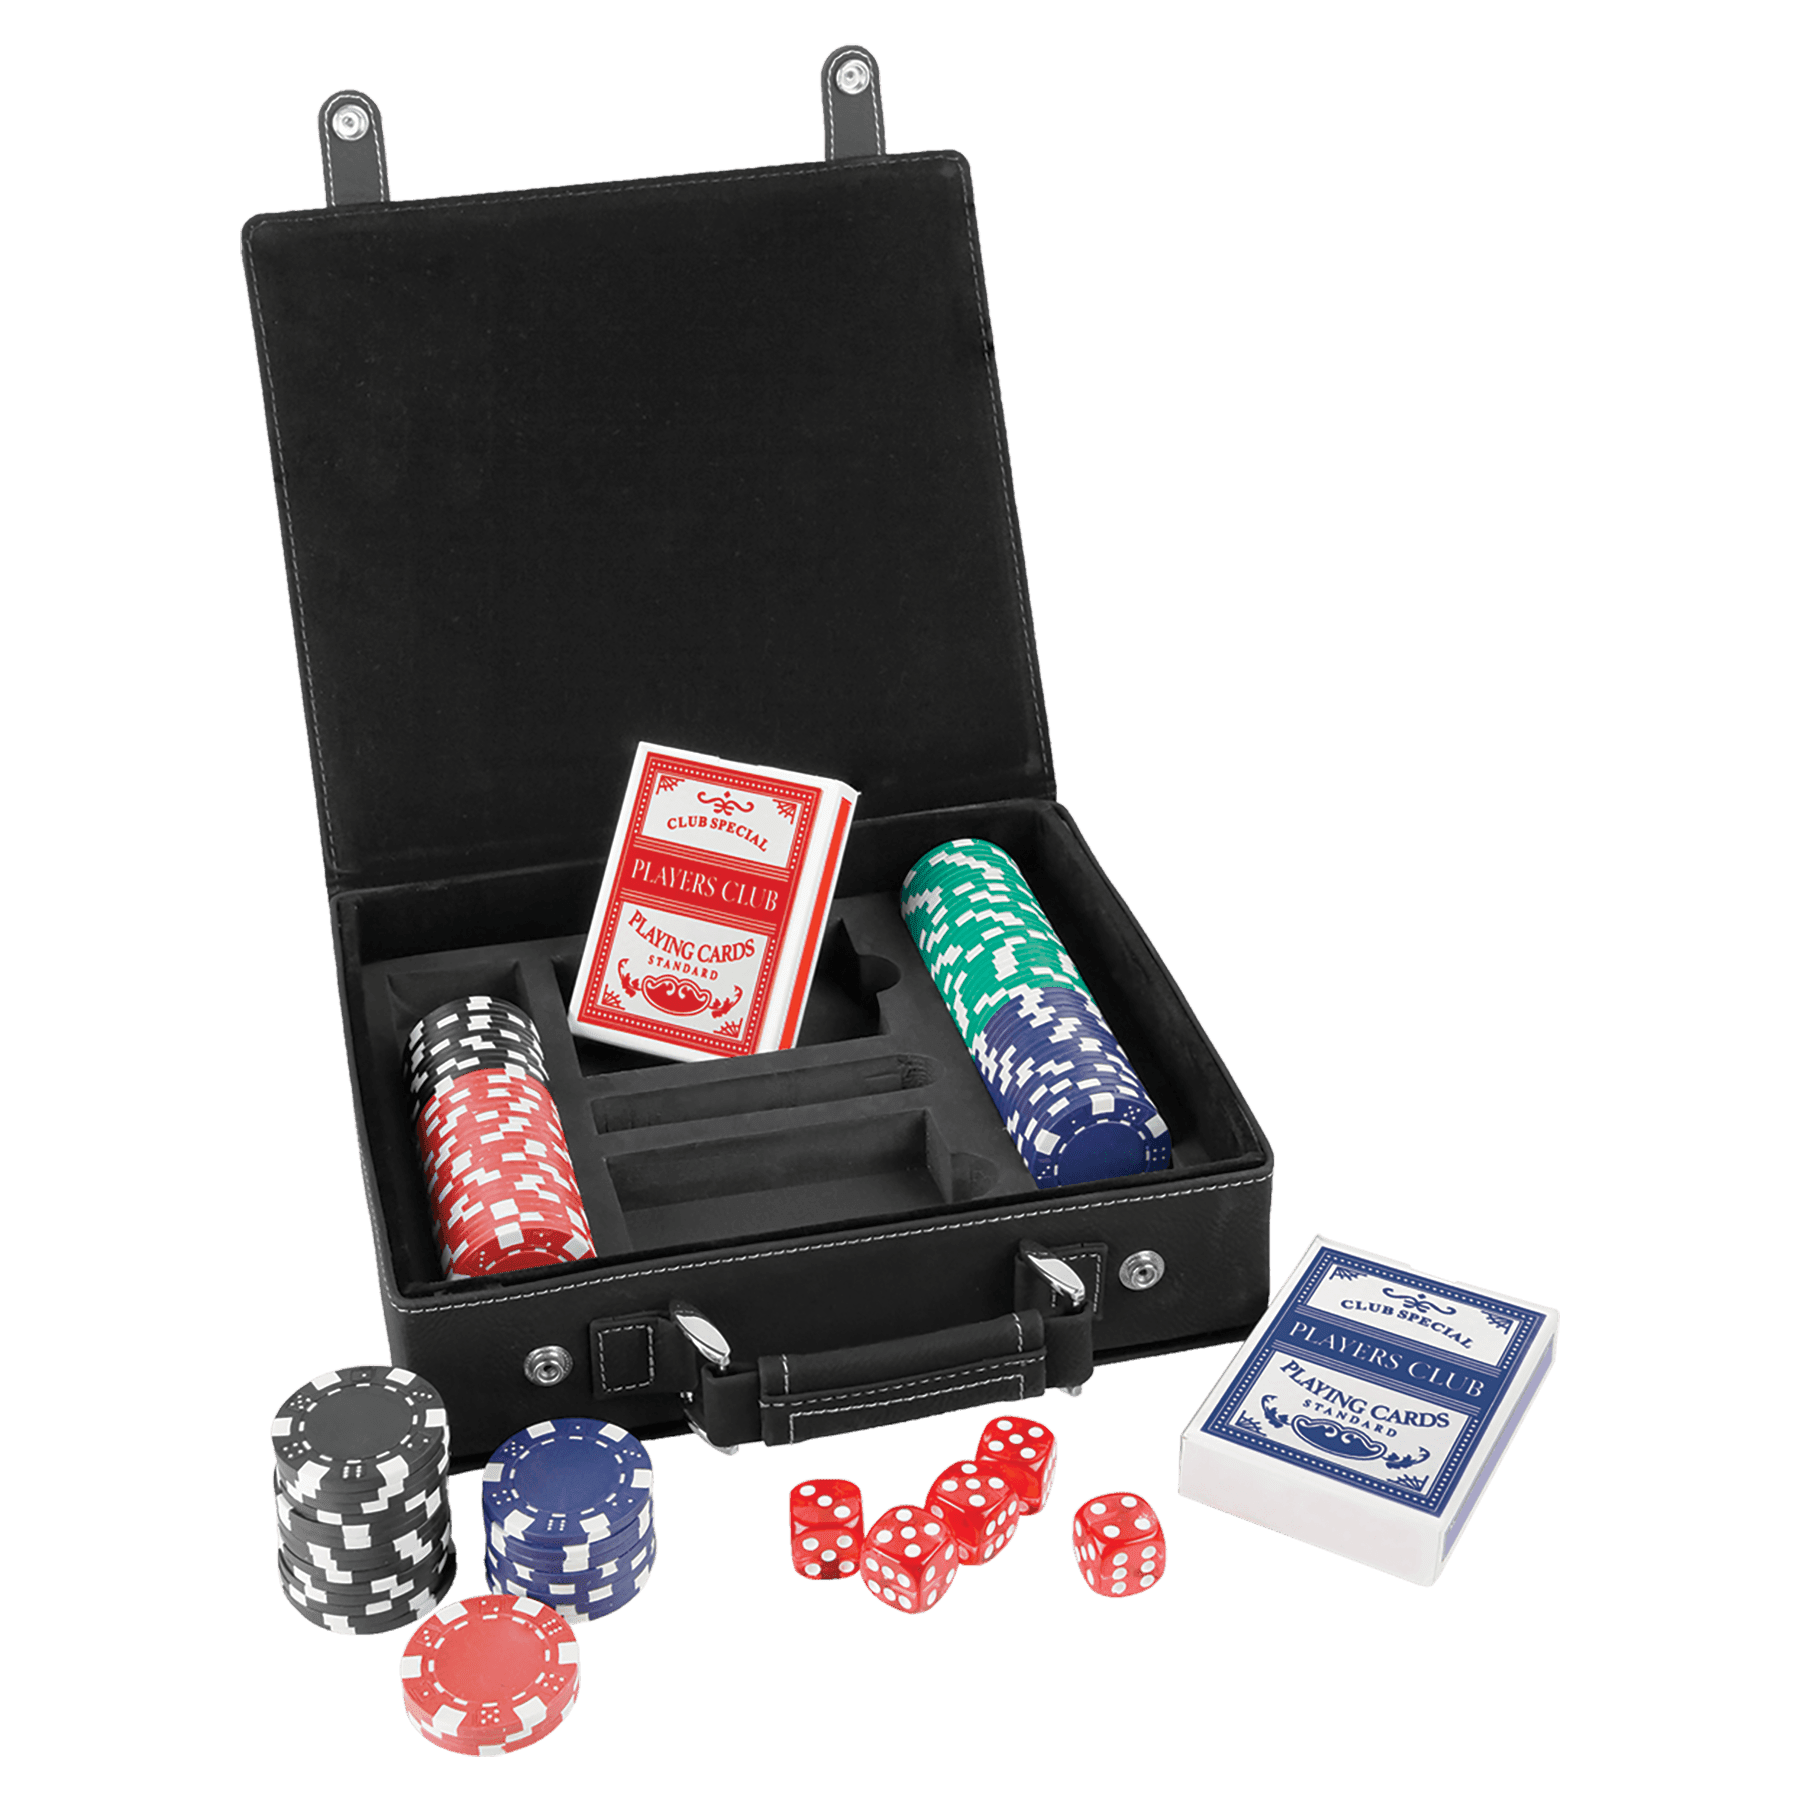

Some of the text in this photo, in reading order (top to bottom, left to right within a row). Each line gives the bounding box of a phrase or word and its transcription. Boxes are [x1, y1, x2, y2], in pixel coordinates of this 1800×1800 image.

[666, 815, 770, 852] CLUB SPECIAL
[631, 858, 779, 912] PLAYERS CLUB
[628, 909, 756, 963] PLAYING CARDS
[647, 954, 719, 981] STANDARD
[1340, 1299, 1474, 1349] CLUB SPECIAL
[1289, 1321, 1485, 1397] PLAYERS CLUB
[1280, 1359, 1450, 1428] PLAYING CARDS
[1302, 1399, 1398, 1438] STANDARD
